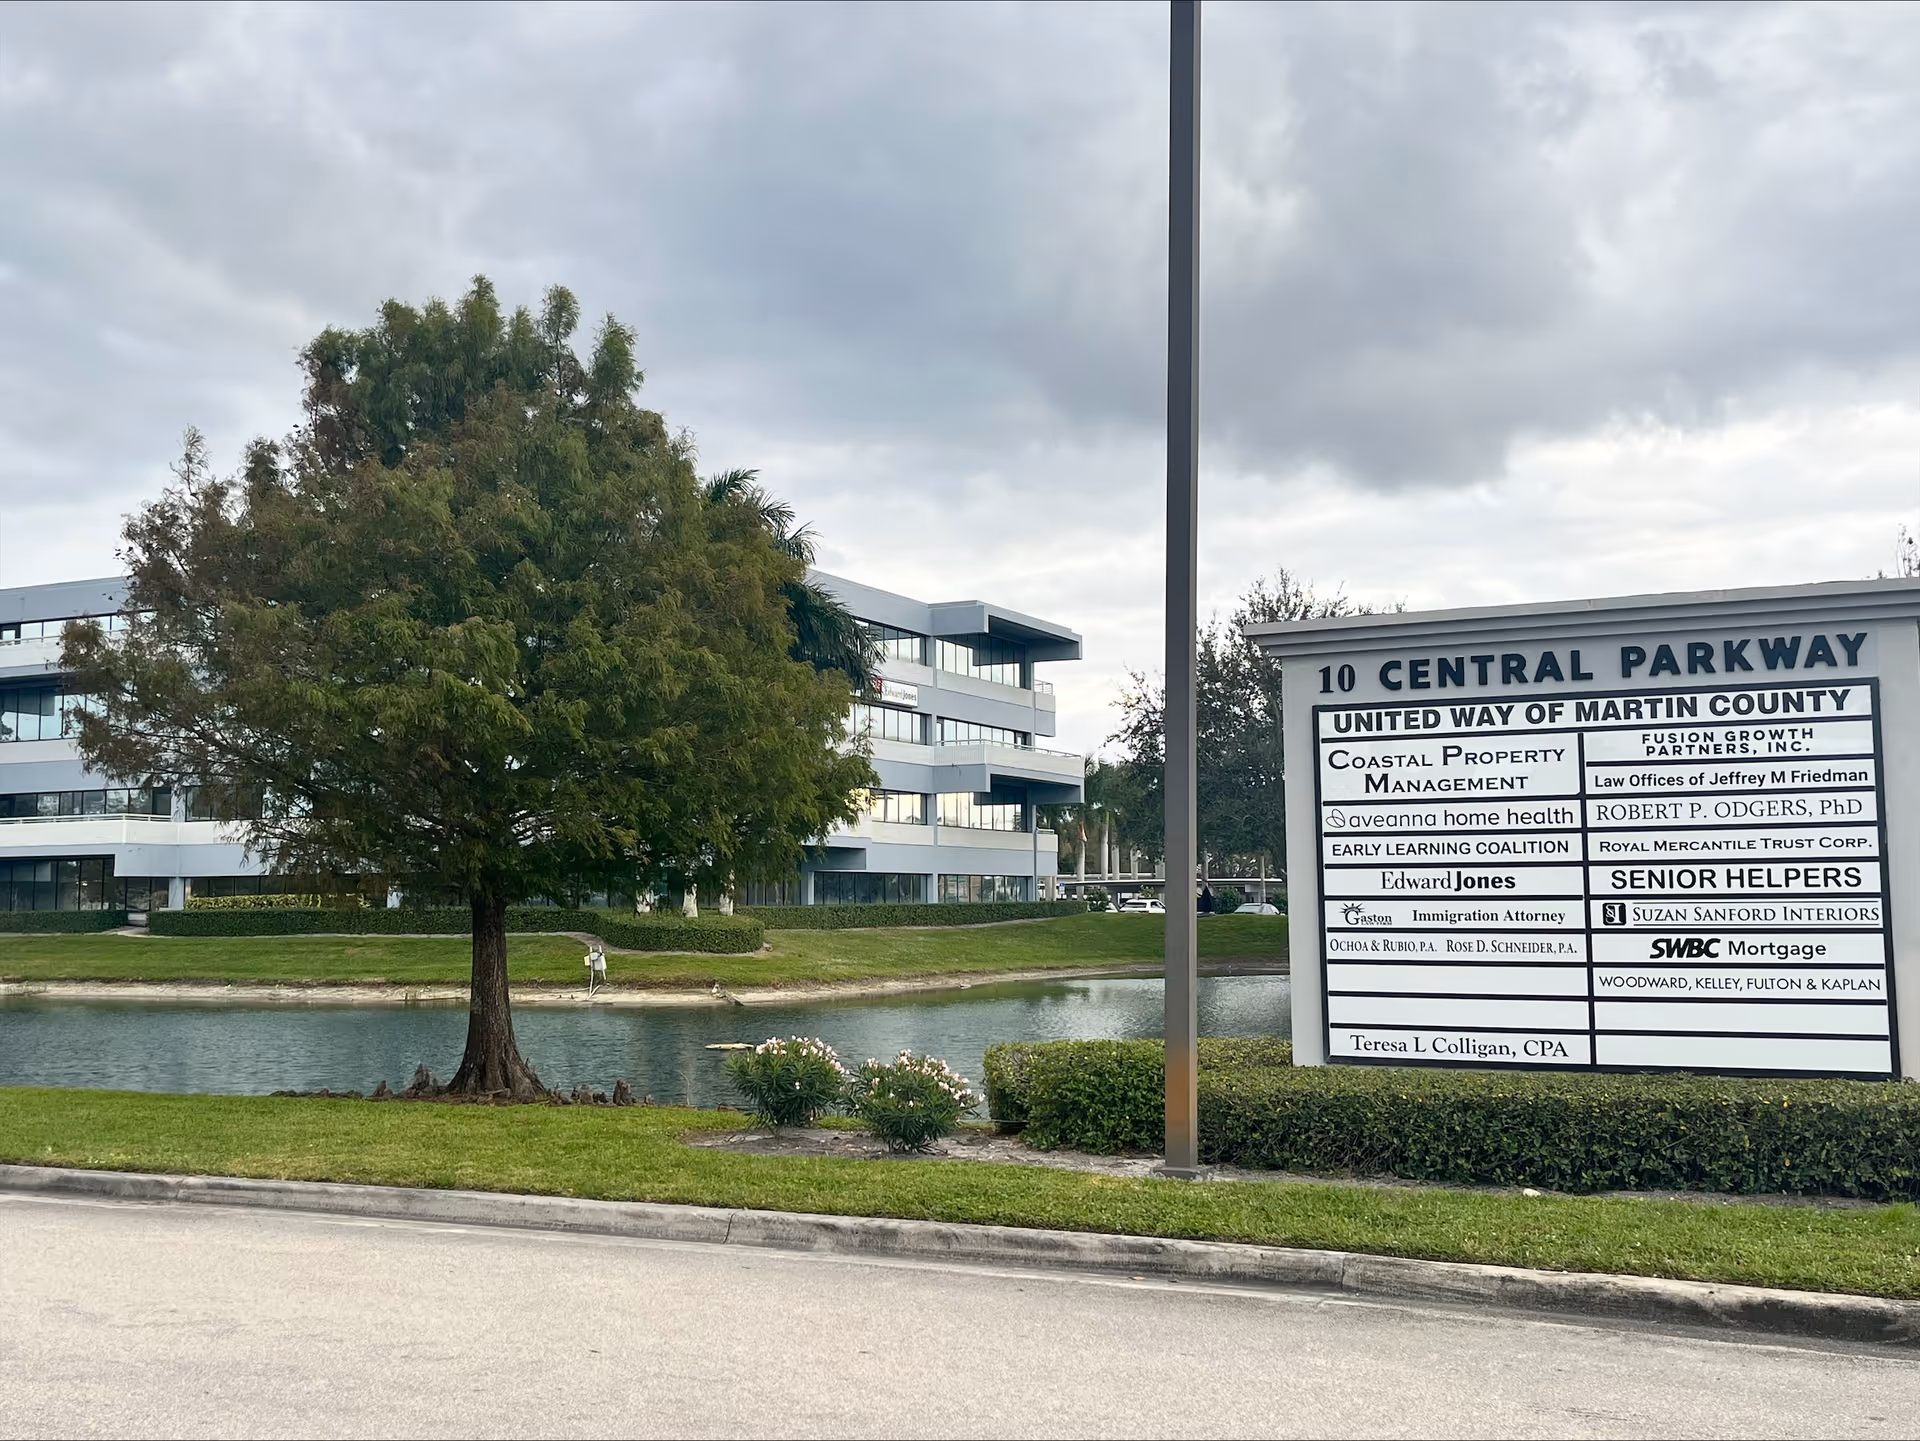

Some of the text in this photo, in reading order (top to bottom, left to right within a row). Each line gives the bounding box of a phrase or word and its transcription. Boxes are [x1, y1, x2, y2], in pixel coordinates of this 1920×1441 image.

[1318, 632, 1867, 693] 10 CENTRAL PARKWAY
[1333, 688, 1851, 733] UNITED WAY OF MARTIN COUNTY
[1642, 728, 1813, 744] FUSION GROWTH
[1646, 741, 1809, 757] PARTNERS, INC.
[1595, 769, 1867, 787] Law Offices of Jeffrey M Friedman
[1350, 808, 1573, 827] aveanna home health
[1597, 799, 1862, 820] ROBERT P. ODGERS, PhD
[1333, 841, 1568, 856] EARLY LEARNING COALITION
[1612, 867, 1861, 889] SENIOR HELPERS
[1345, 909, 1392, 925] Gaston
[1413, 910, 1565, 924] Immigration Attorney
[1371, 940, 1379, 951] &
[1477, 940, 1488, 952] D.
[1650, 938, 1826, 959] SWBC Mortgage
[1599, 976, 1880, 991] WOODWARD, KELLEY, FULTON & KAPLAN
[1350, 1035, 1568, 1058] Teresa L Colligan, CPA
